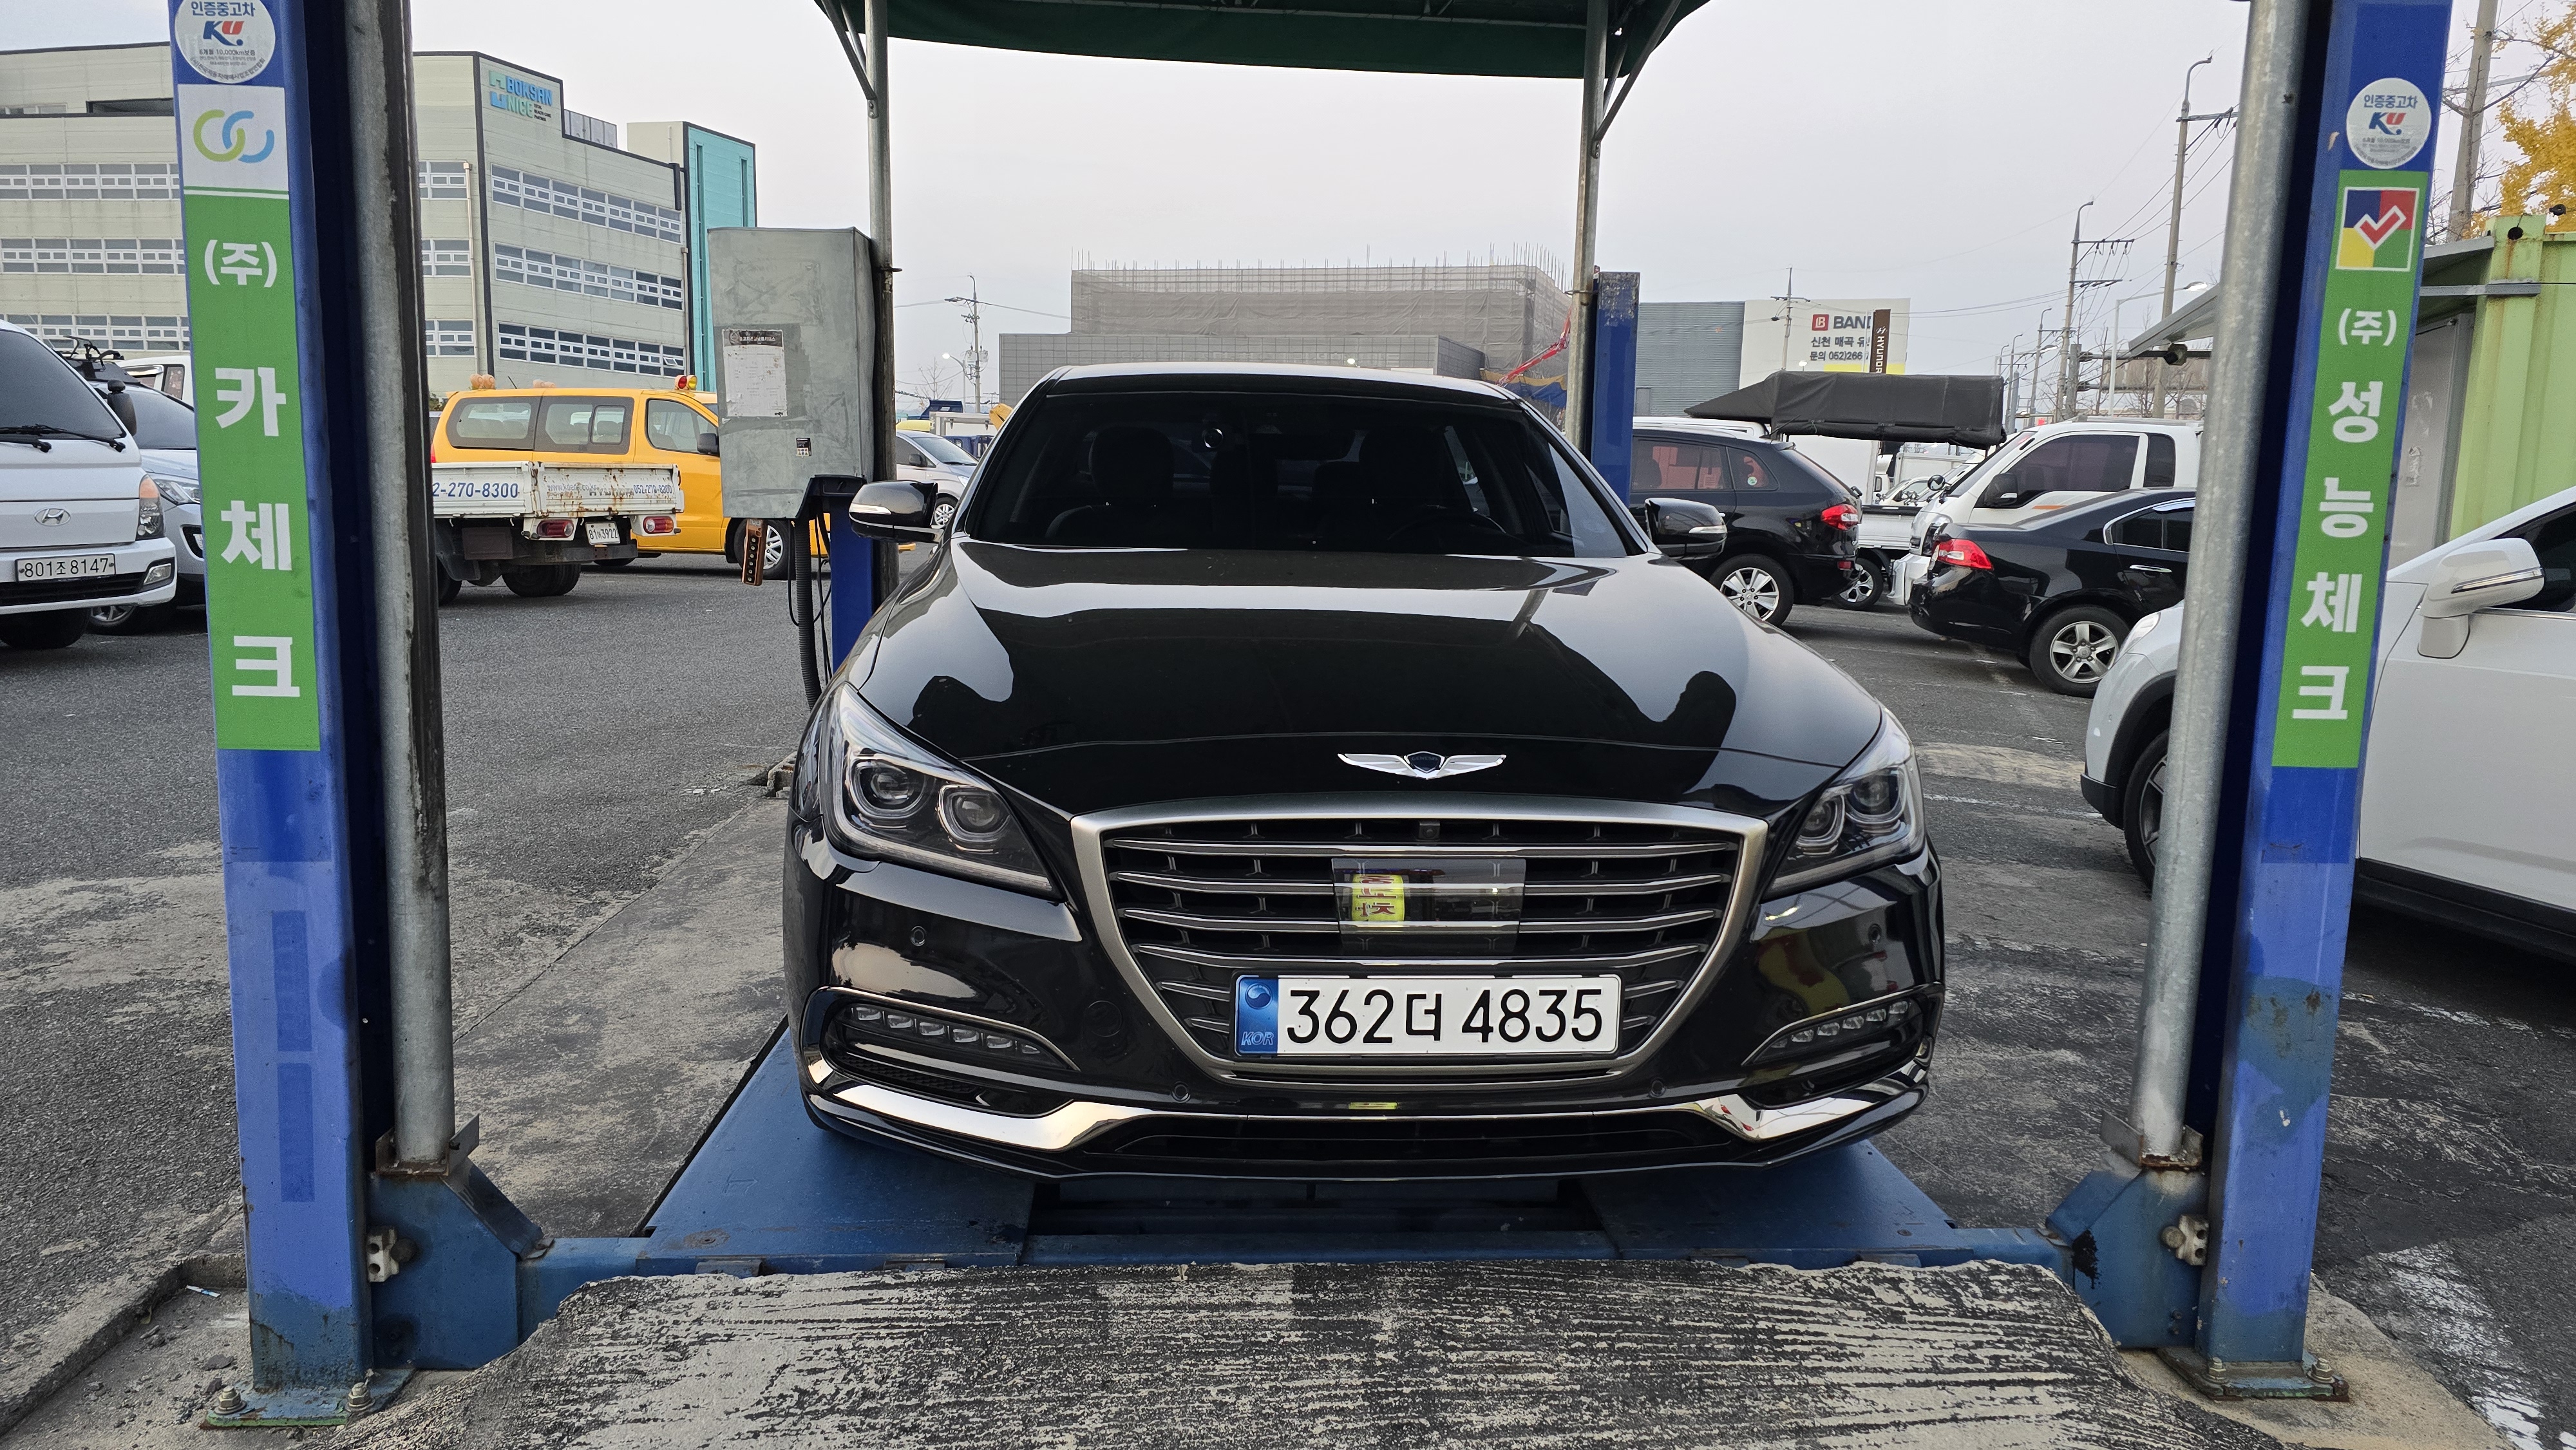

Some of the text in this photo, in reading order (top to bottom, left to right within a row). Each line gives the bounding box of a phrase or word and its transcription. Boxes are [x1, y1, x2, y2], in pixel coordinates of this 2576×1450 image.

[191, 1, 256, 17] 인증중고차
[506, 75, 553, 106] BOKSAN
[506, 94, 533, 118] NICE
[2363, 94, 2418, 109] 인증중고차
[1811, 336, 1831, 348] 신천
[1835, 336, 1854, 348] 매곡
[1810, 351, 1826, 361] 문의
[1828, 350, 1863, 361] 052)266
[24, 558, 109, 578] 801조 8147
[1287, 989, 1602, 1044] 362더 4835
[1240, 1031, 1274, 1046] KOR
